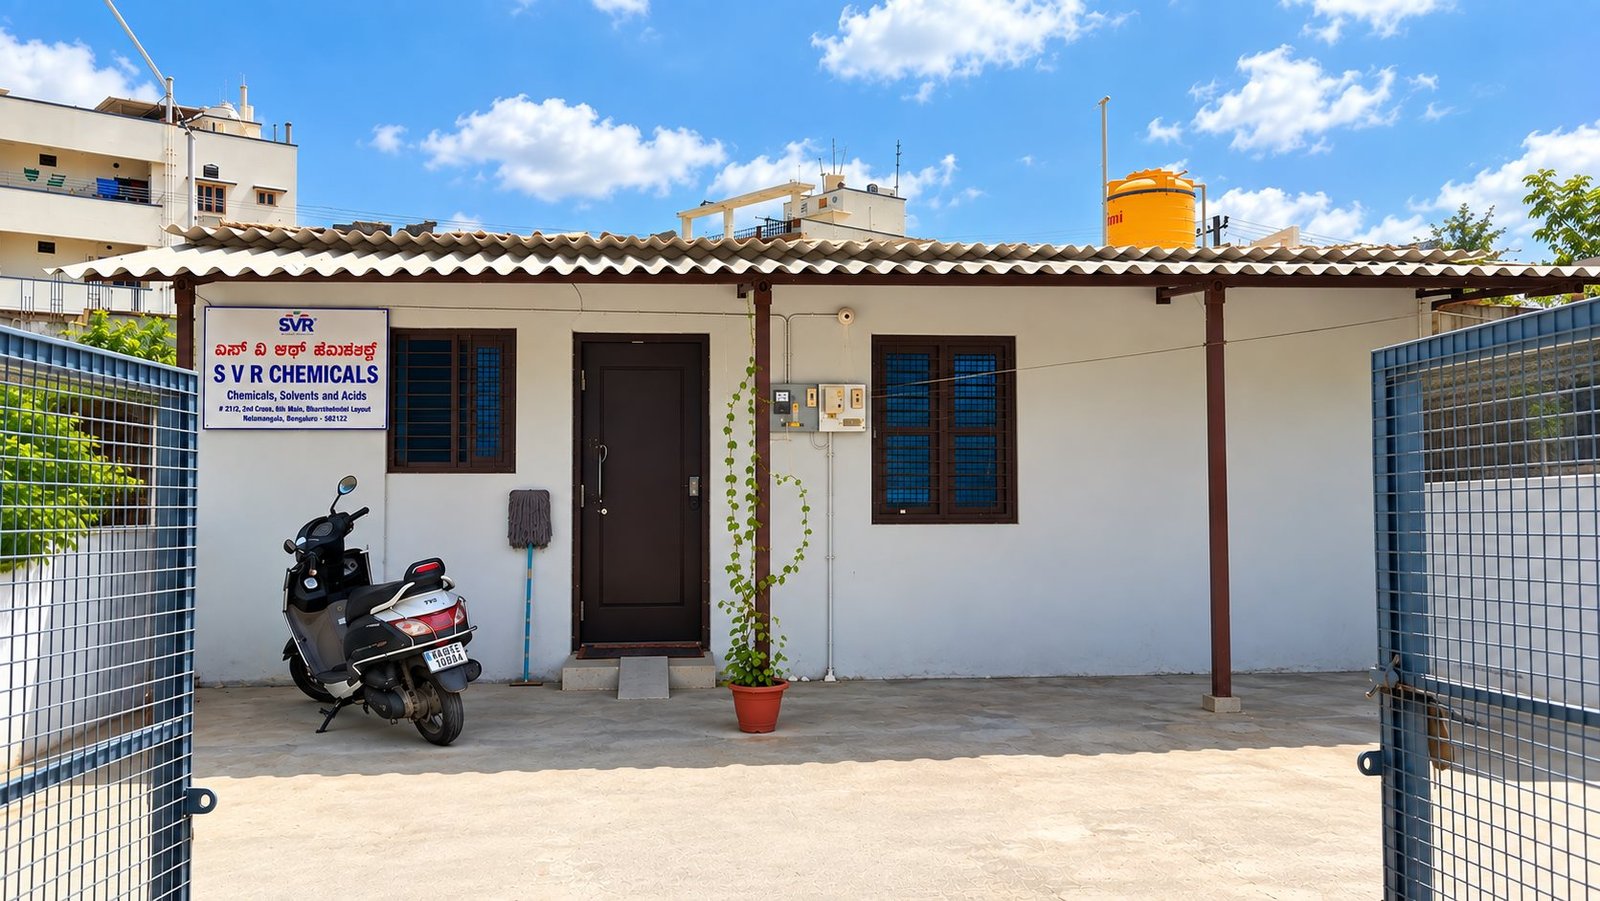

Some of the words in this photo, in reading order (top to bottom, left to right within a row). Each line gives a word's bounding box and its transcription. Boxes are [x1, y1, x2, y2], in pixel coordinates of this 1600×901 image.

[279, 317, 314, 332] SVR
[213, 364, 226, 383] S
[231, 364, 245, 383] V
[250, 364, 263, 383] R
[269, 364, 379, 384] CHEMICALS
[227, 390, 277, 402] Chemicals,
[280, 390, 319, 401] Solvents
[322, 391, 339, 401] and
[341, 391, 367, 401] Acids
